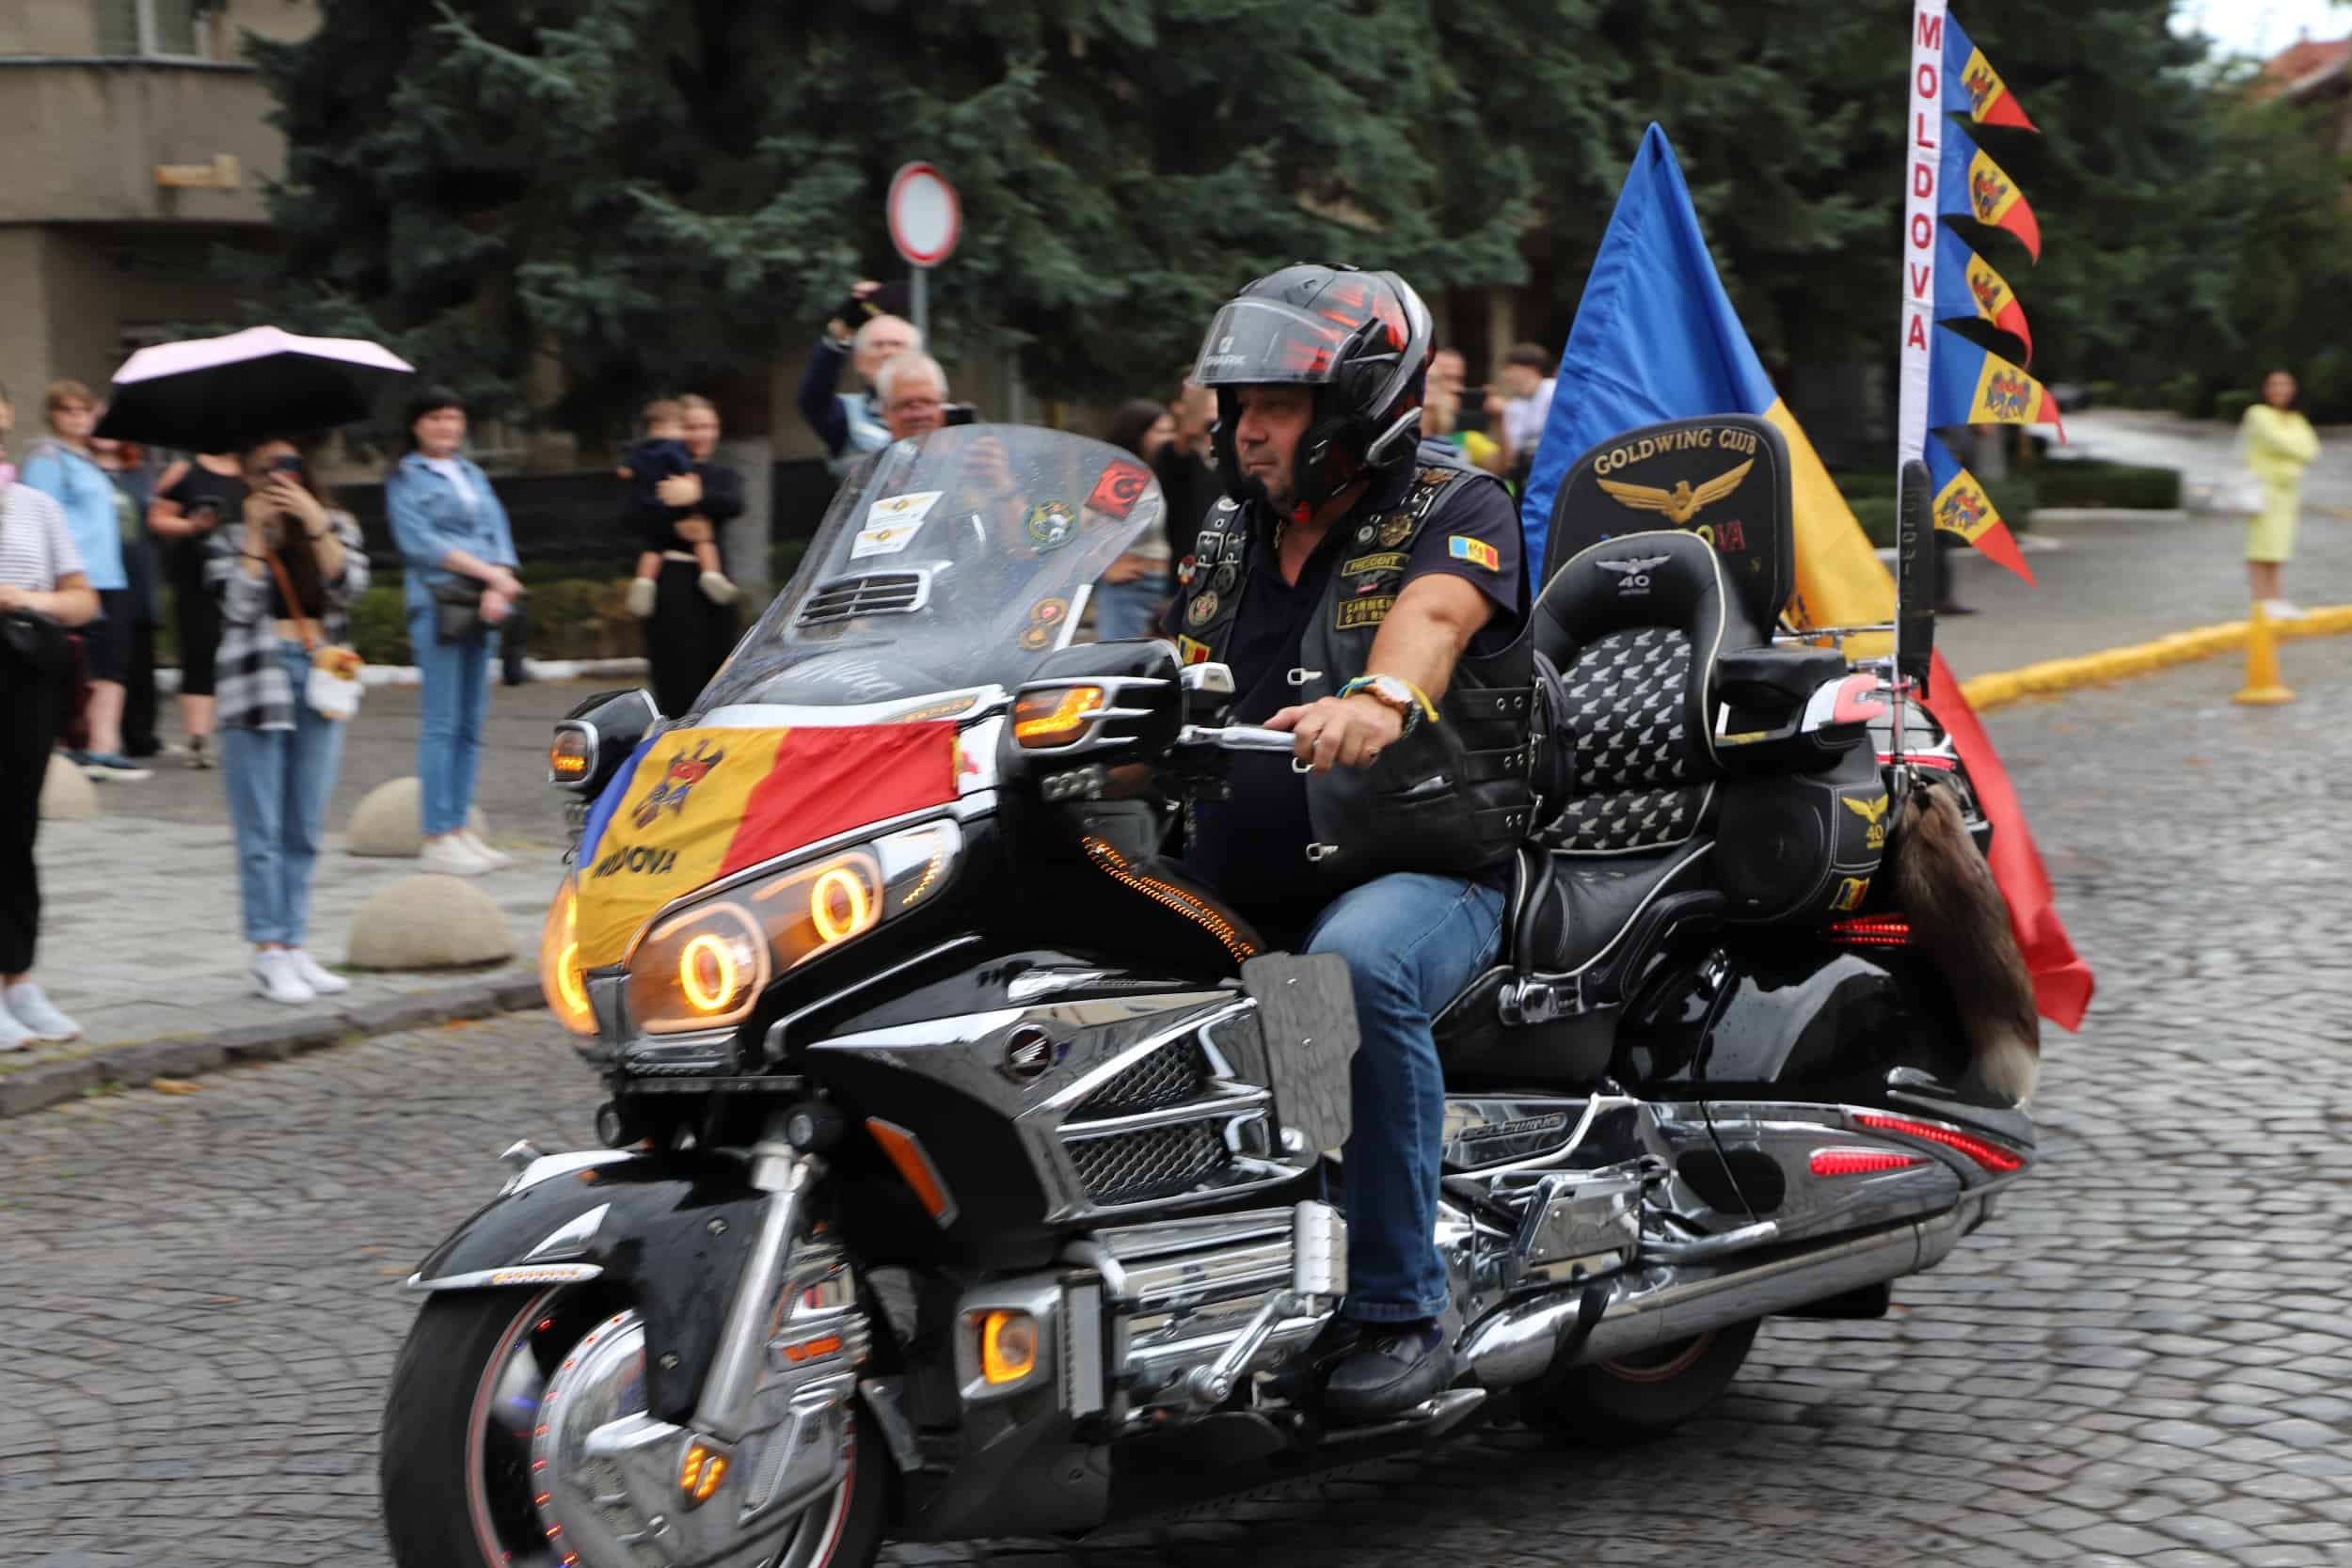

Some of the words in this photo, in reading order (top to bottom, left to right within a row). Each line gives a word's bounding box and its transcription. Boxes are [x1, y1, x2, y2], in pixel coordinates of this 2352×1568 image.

[1906, 12, 1942, 351] MOLDOVA
[1594, 429, 1712, 474] GOLDWING
[1719, 428, 1757, 455] CLUB
[1618, 575, 1650, 588] 40
[1867, 825, 1883, 841] 40
